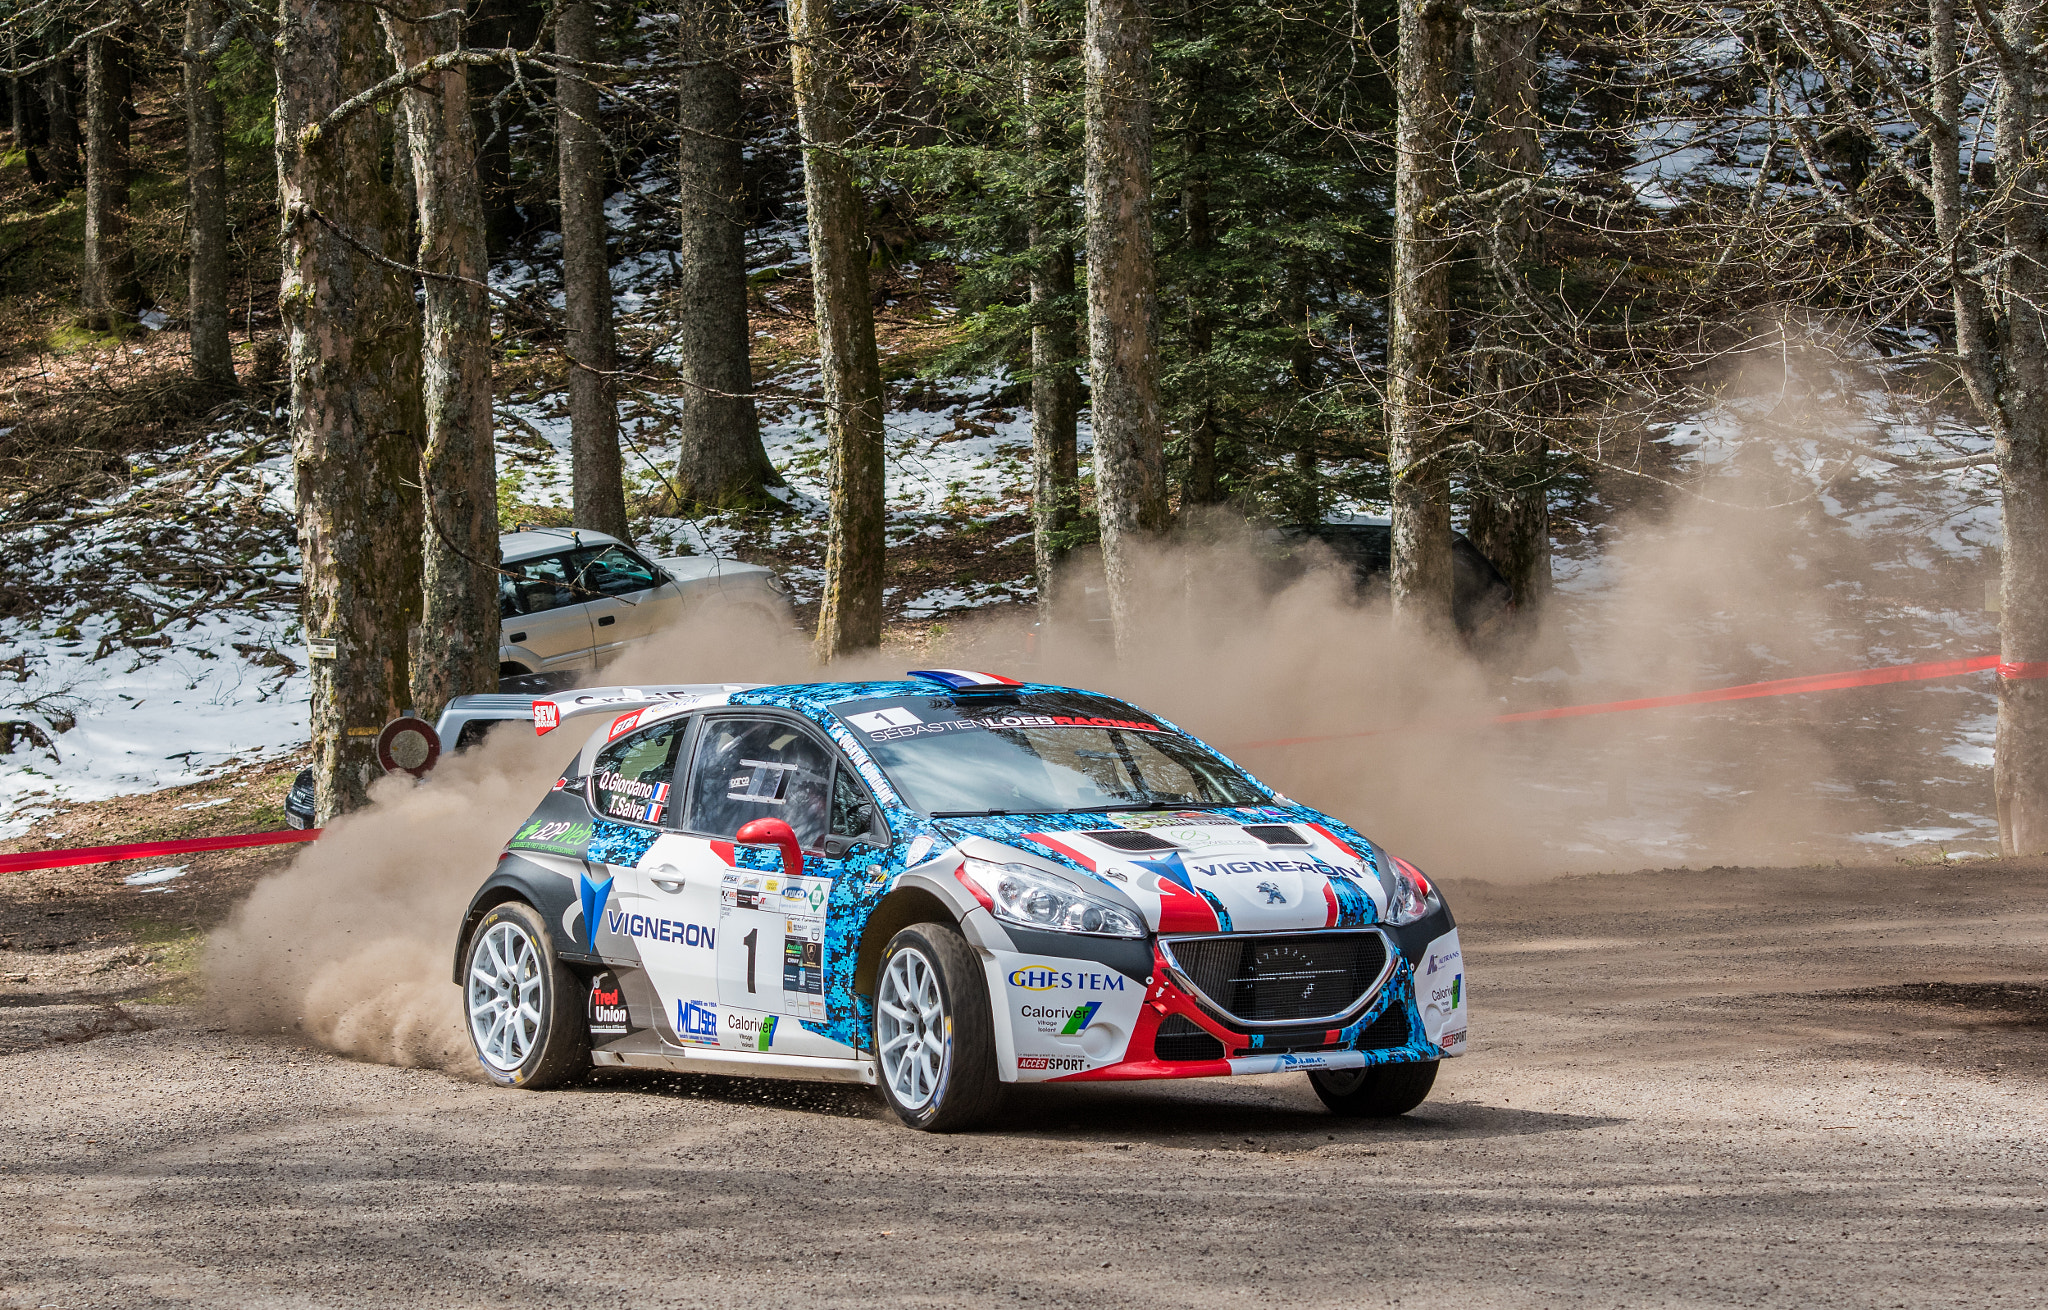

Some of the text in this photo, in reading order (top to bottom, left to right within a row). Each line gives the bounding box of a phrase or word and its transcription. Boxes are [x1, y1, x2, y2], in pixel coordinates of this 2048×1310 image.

[534, 705, 557, 720] SEW
[873, 712, 897, 726] 1
[608, 795, 645, 820] T.Salva
[1192, 861, 1363, 879] VIGNERON
[608, 910, 716, 950] VIGNERON
[743, 928, 758, 994] 1
[593, 988, 619, 1006] Tred
[595, 1005, 627, 1022] Union
[677, 998, 718, 1036] MOSER
[1021, 1005, 1089, 1019] Caloriver
[728, 1014, 774, 1034] Caloriver
[1019, 1057, 1085, 1071] ACCÈS SPORT
